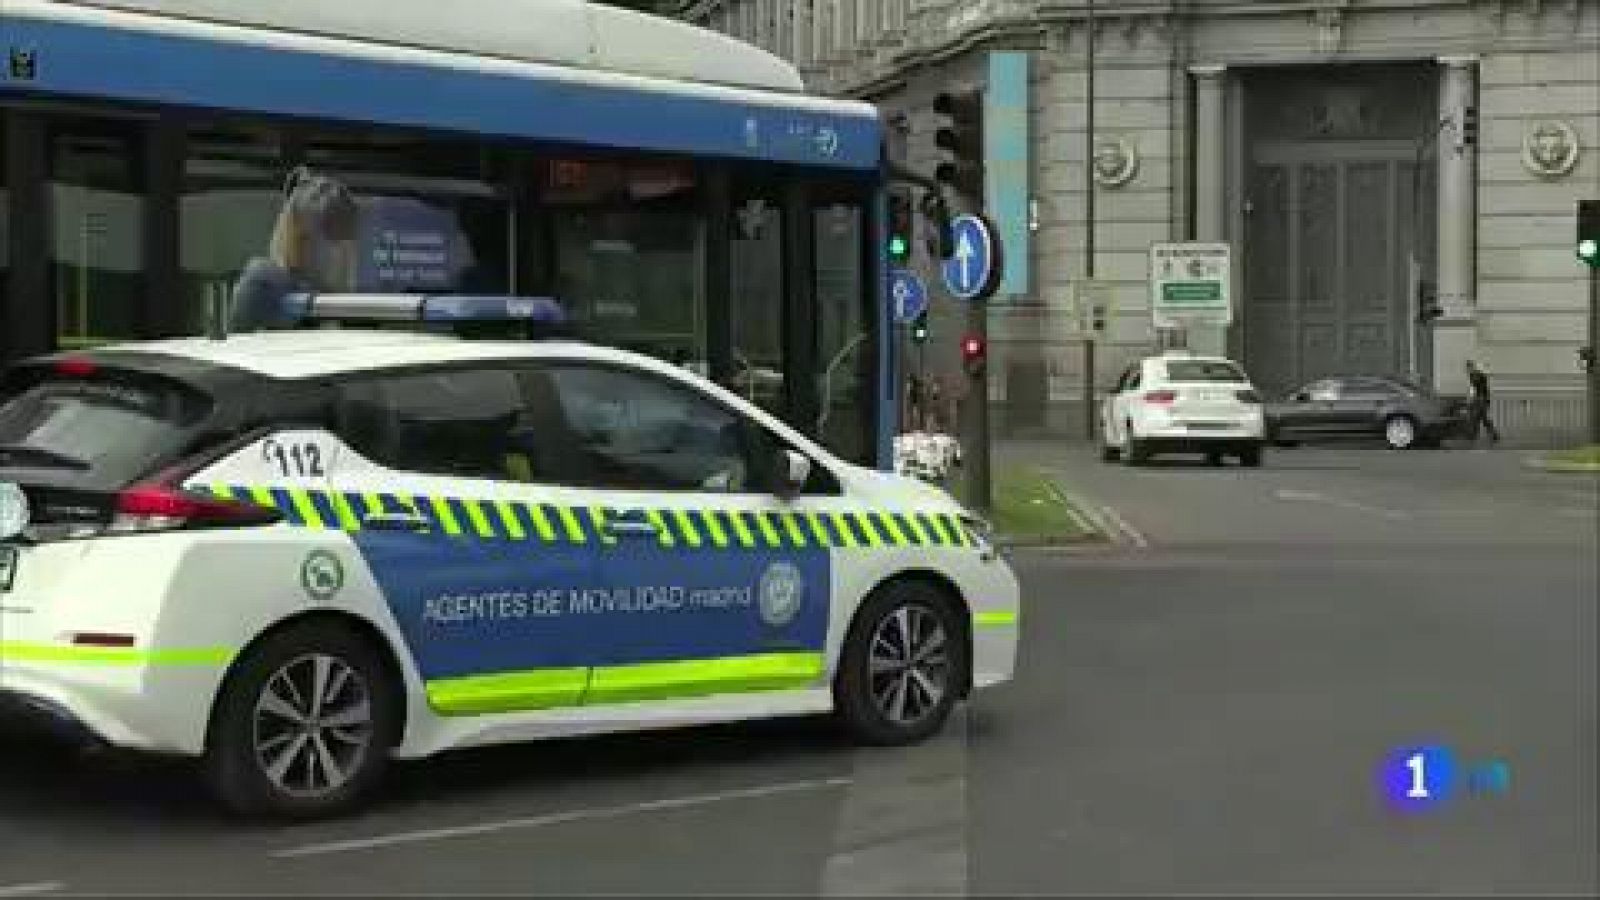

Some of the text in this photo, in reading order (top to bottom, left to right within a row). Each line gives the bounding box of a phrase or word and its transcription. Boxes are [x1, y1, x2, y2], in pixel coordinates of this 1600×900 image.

[274, 442, 324, 477] 112
[423, 586, 752, 620] AGENTES DE MOVILIDAD madrid
